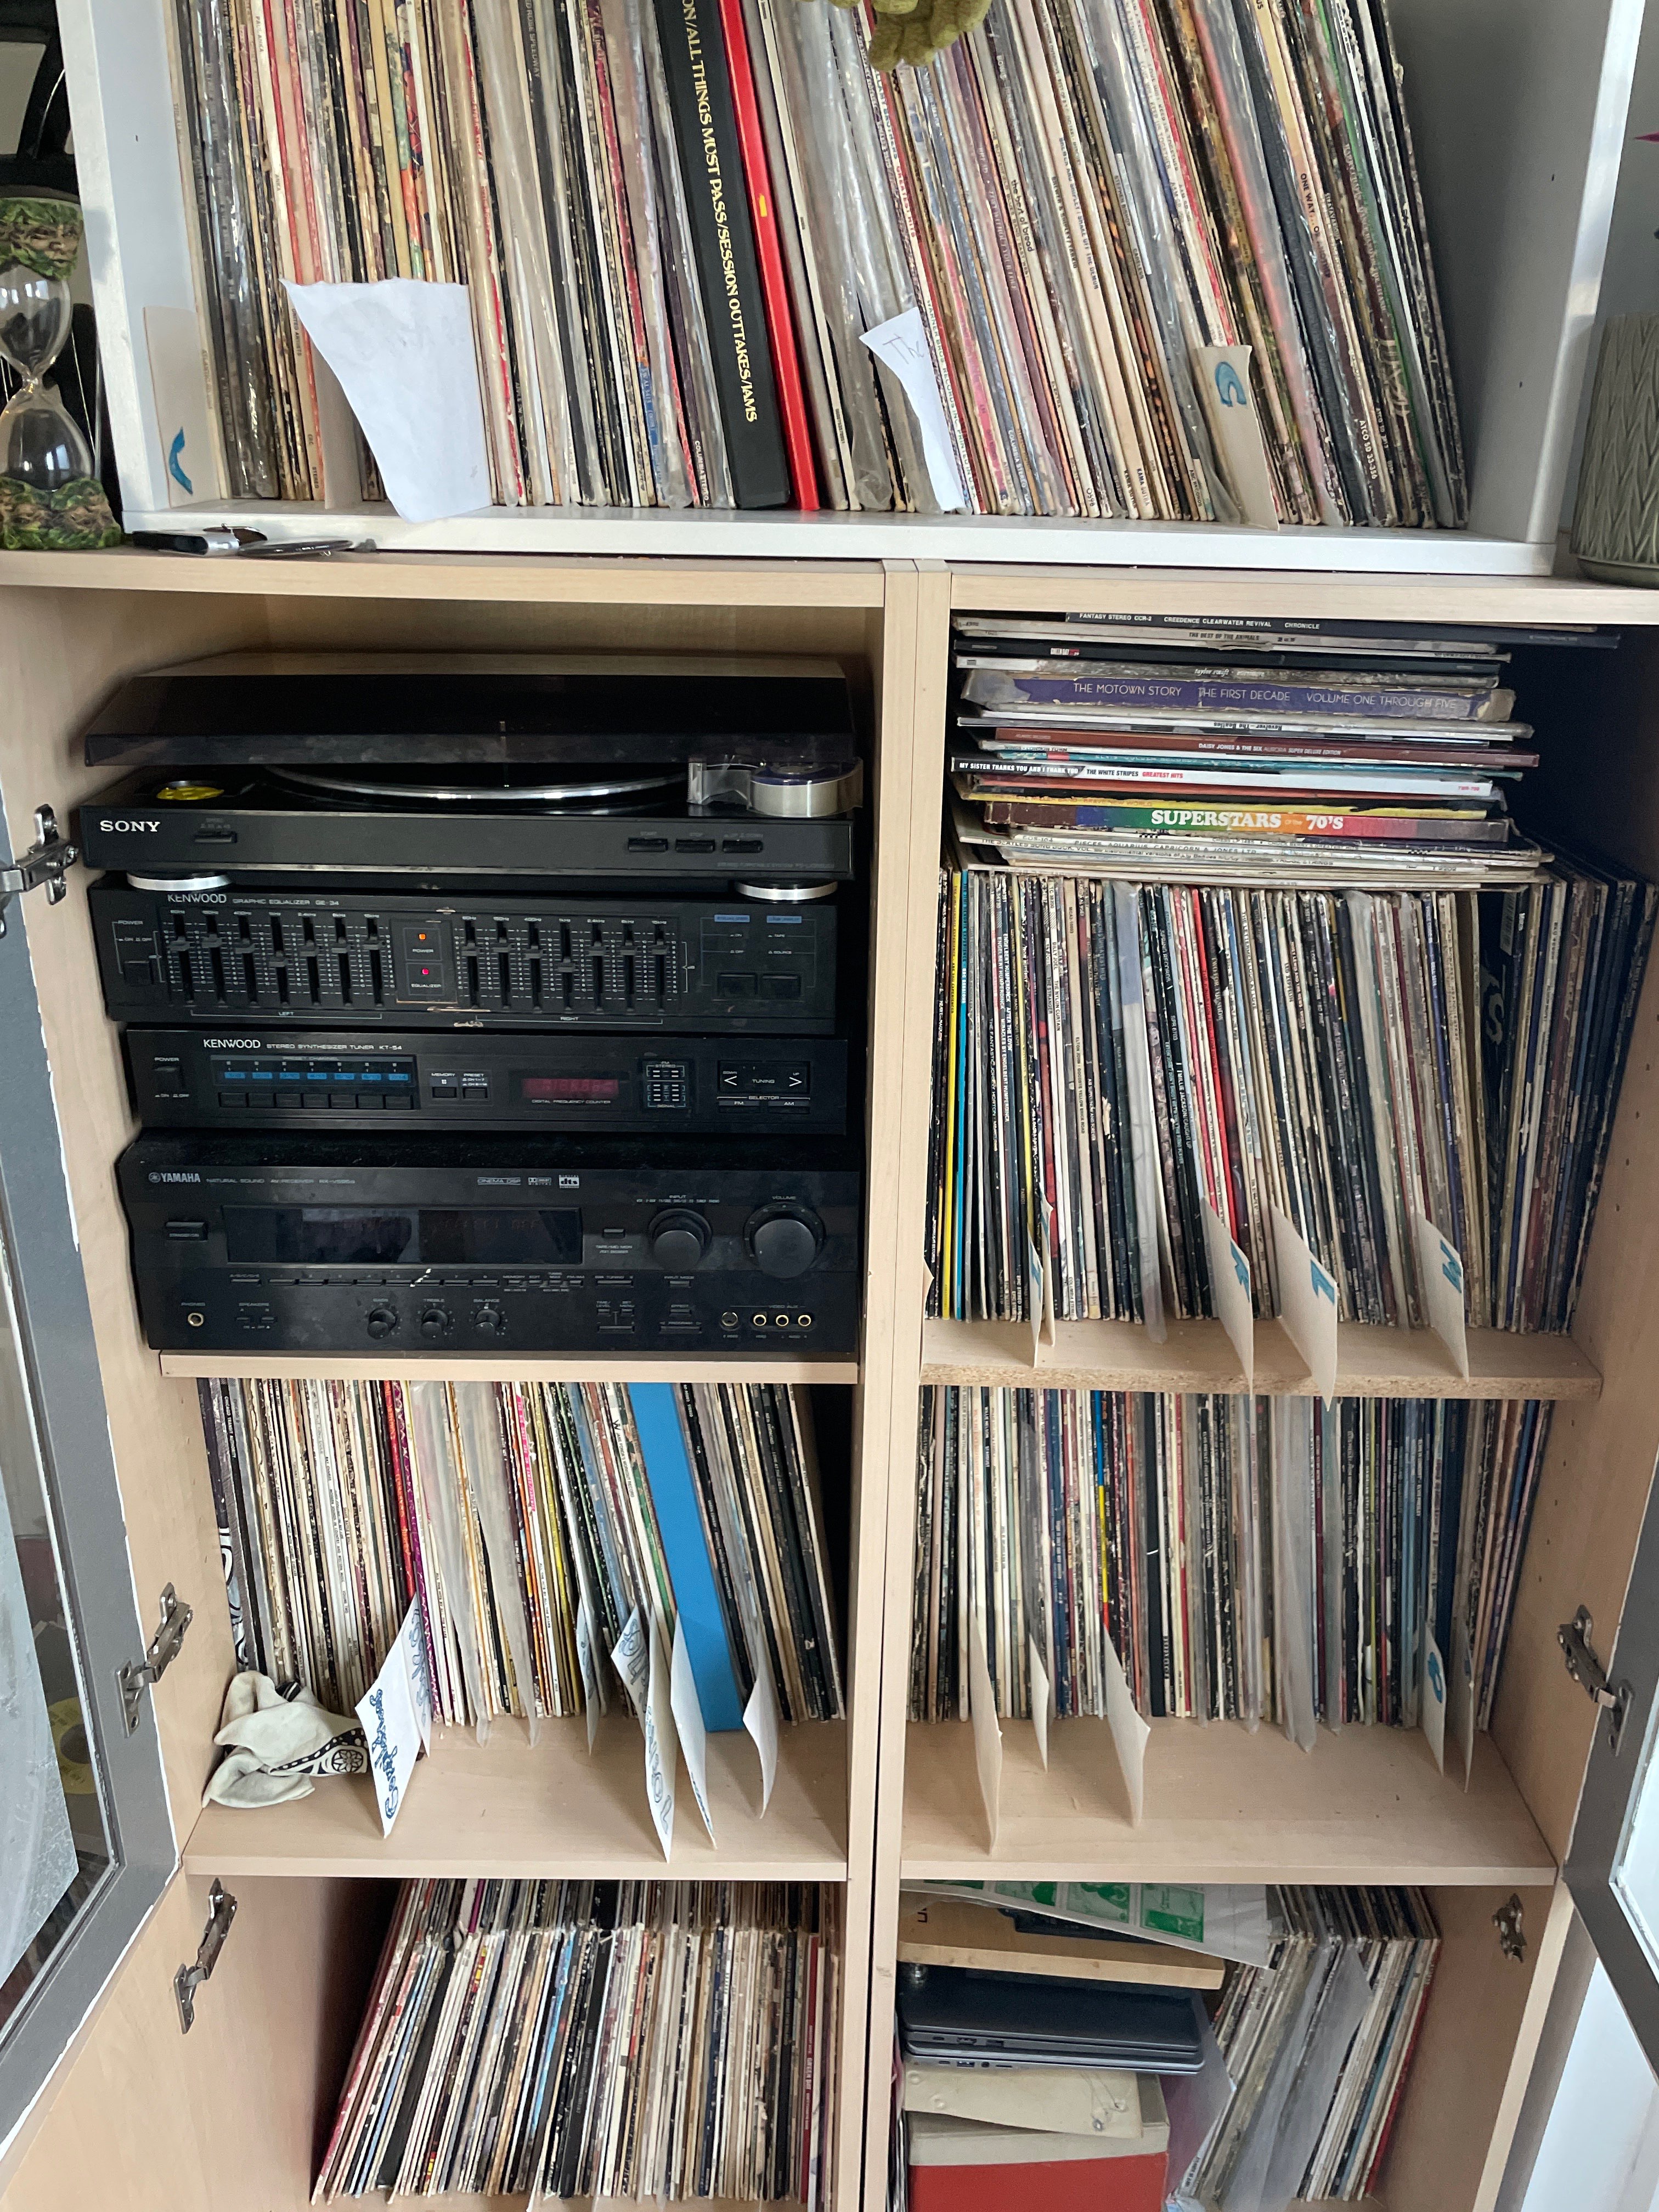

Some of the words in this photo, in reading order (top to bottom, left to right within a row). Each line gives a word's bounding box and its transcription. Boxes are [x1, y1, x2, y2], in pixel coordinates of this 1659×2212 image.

[692, 60, 712, 125] THINGS
[702, 128, 720, 175] MUST
[1300, 173, 1311, 191] ONE
[896, 166, 911, 213] GREATEST
[906, 216, 916, 238] HITS
[1011, 180, 1019, 194] the
[1015, 196, 1026, 216] best
[1023, 227, 1035, 252] bread
[1359, 420, 1369, 441] ATCO
[1074, 682, 1093, 693] THE
[1097, 684, 1146, 695] MOTOWN
[1148, 686, 1182, 697] STORY
[1220, 689, 1247, 699] FIRST
[1250, 690, 1290, 701] DECADE
[1307, 692, 1350, 703] VOLUME
[1353, 695, 1376, 705] ONE
[1379, 696, 1432, 707] THROUGH
[1435, 699, 1457, 709] FIVE
[100, 820, 161, 832] SONY
[1151, 809, 1282, 828] SUPERSTARS
[1306, 814, 1344, 830] 70'S
[167, 893, 227, 904] KENWOOD
[203, 1039, 261, 1048] KENWOOD
[1180, 1091, 1190, 1139] JACKSON/CAUGHT
[161, 1173, 201, 1183] YAMAHA
[227, 1417, 235, 1434] TRANSIT
